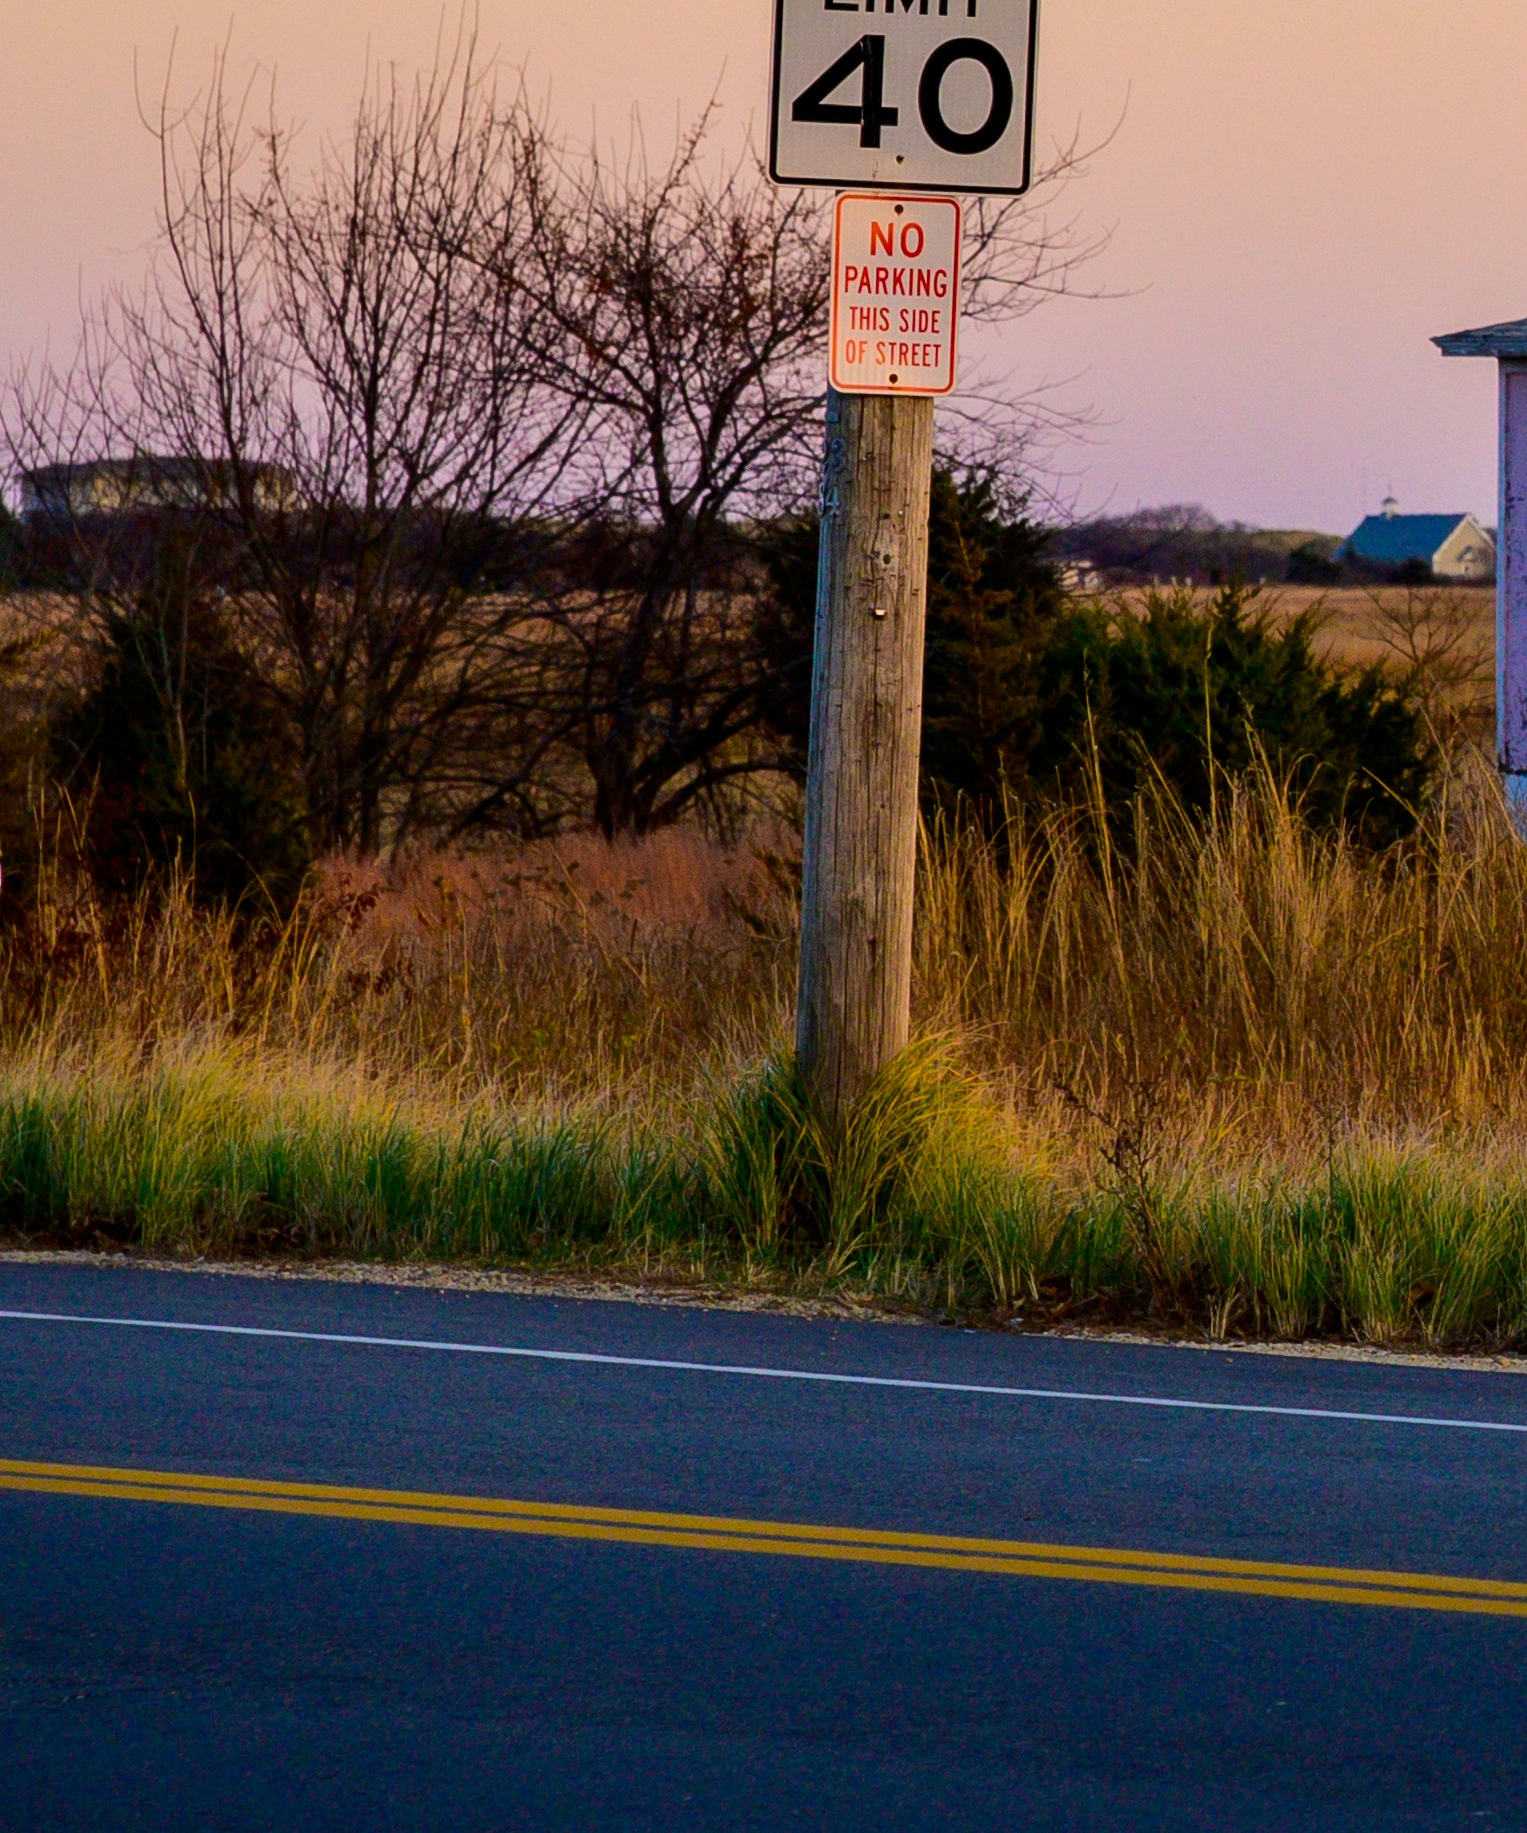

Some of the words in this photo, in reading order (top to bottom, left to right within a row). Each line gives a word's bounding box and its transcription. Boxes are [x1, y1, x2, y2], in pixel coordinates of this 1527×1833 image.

[791, 34, 1014, 156] 40
[869, 221, 925, 259] NO
[844, 265, 948, 298] PARKING
[849, 306, 890, 332] THIS
[899, 308, 941, 334] SIDE
[845, 339, 868, 365] OF
[875, 341, 942, 368] STREET
